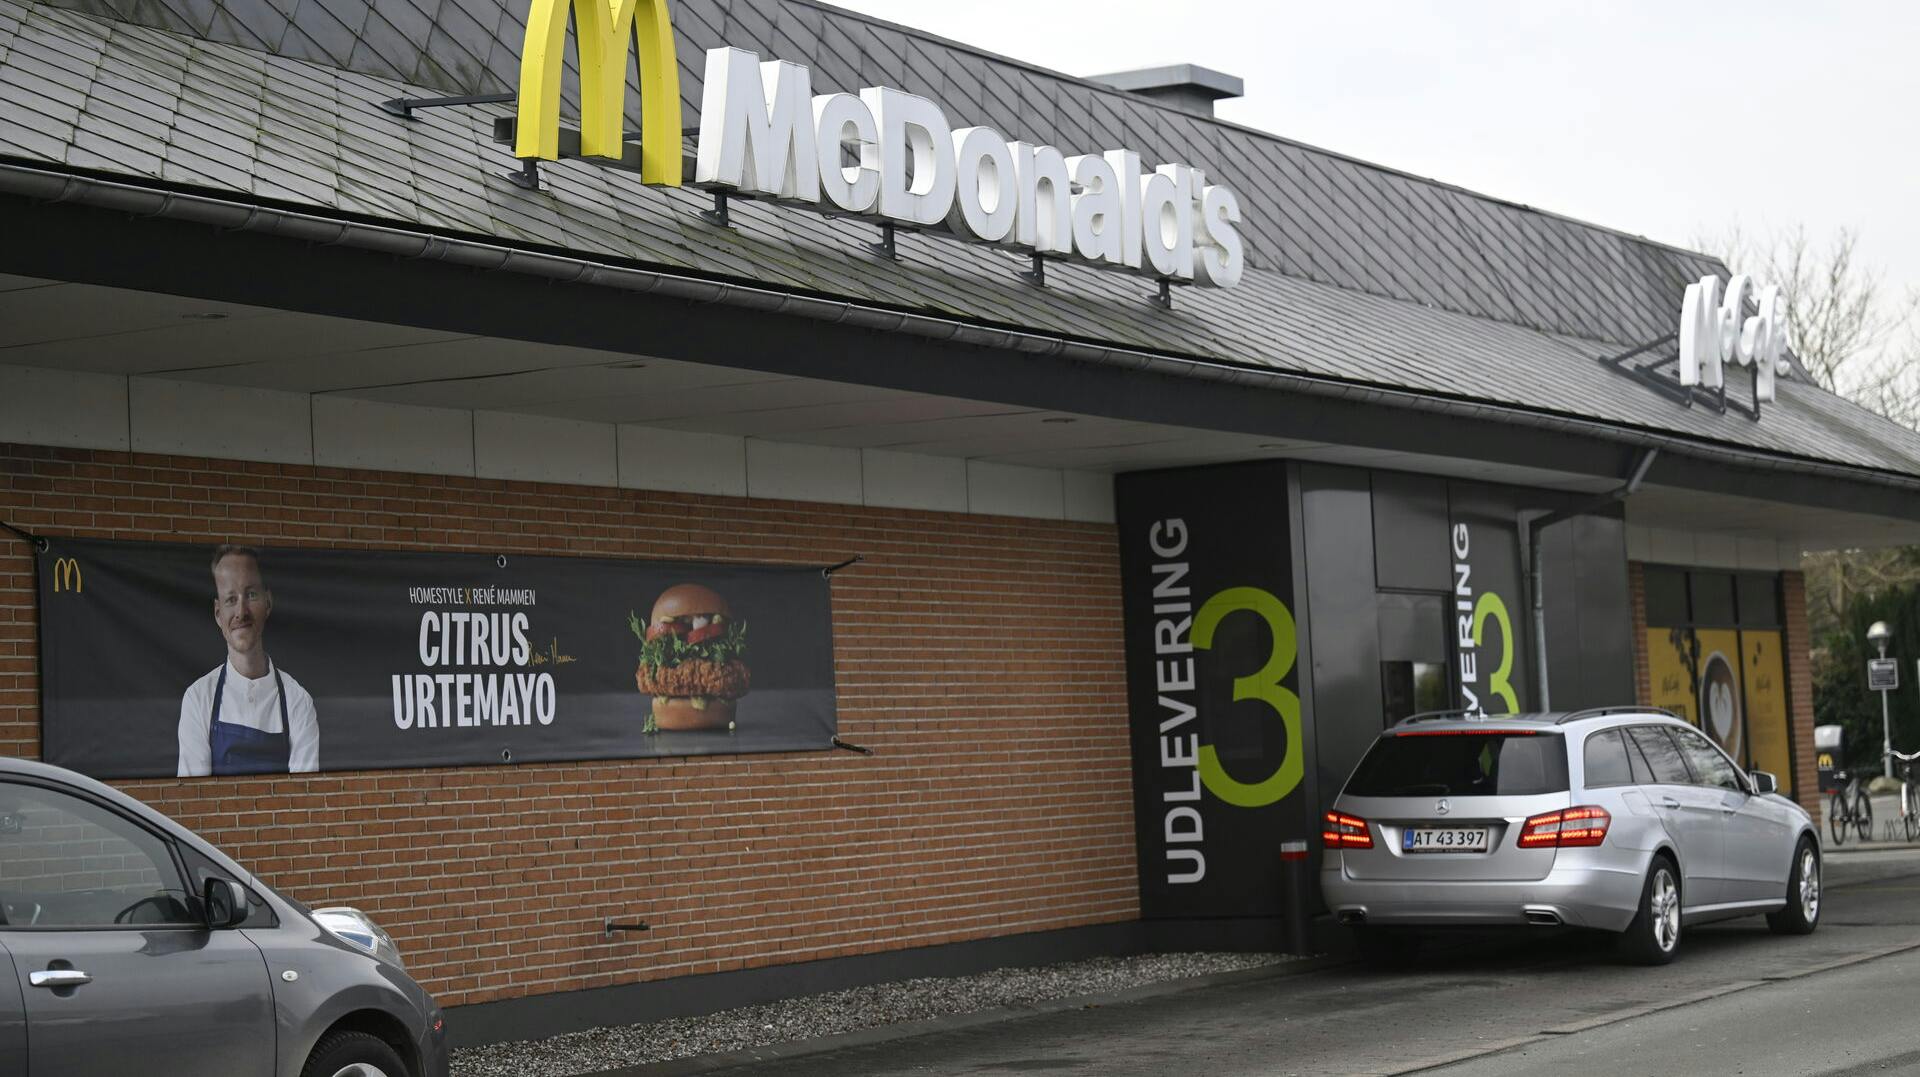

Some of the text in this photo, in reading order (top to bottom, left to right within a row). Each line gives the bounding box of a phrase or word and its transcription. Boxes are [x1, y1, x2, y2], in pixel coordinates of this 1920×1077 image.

[695, 46, 1244, 289] McDonald's
[409, 586, 464, 605] HOMESTYLE
[472, 585, 496, 605] RENÉ
[497, 589, 536, 606] MAMMEN
[419, 610, 529, 667] CITRUS
[1453, 522, 1477, 720] VERING
[391, 672, 556, 730] URTEMAYO
[1149, 517, 1206, 884] UDLEVERING
[1188, 586, 1304, 808] 3
[1413, 831, 1484, 846] AT 43 397
